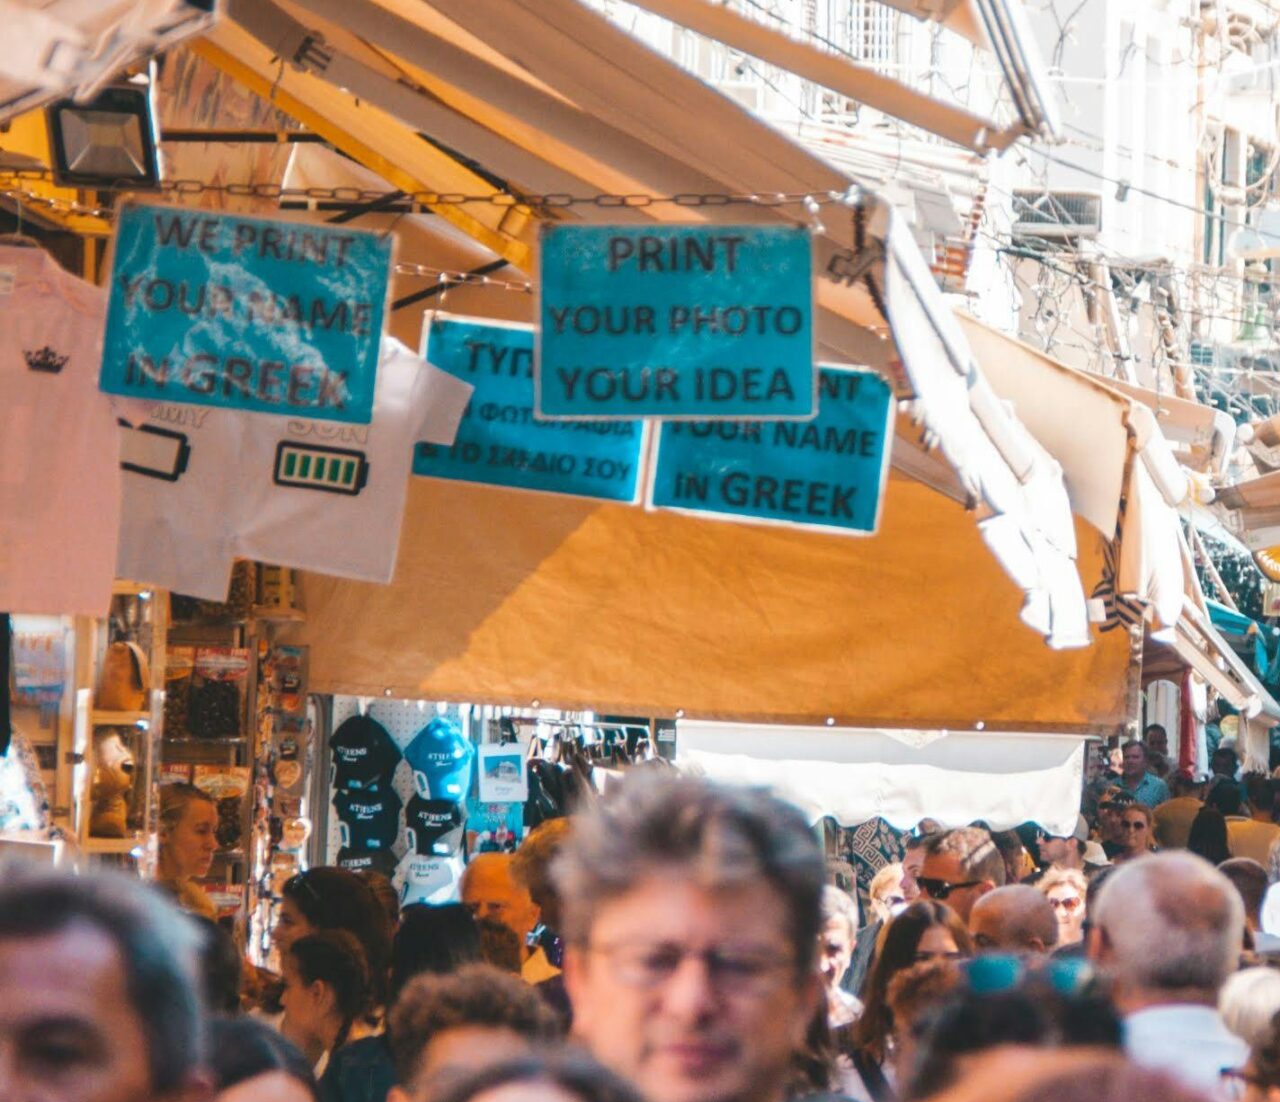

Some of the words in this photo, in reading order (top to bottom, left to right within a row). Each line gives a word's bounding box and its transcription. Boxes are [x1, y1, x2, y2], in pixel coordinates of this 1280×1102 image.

[154, 214, 220, 251] WE
[235, 222, 355, 267] PRINT
[608, 236, 745, 272] PRINT
[119, 273, 234, 318] YOUR
[246, 294, 372, 336] NAME
[549, 304, 656, 336] YOUR
[668, 304, 803, 337] PHOTO
[124, 353, 168, 390] IN
[184, 354, 351, 410] GREEK
[556, 367, 680, 402] YOUR
[695, 367, 795, 402] IDEA
[773, 419, 878, 457] NAME
[583, 454, 633, 481] ΣΟΥ
[673, 470, 708, 501] IN
[719, 470, 859, 519] GREEK
